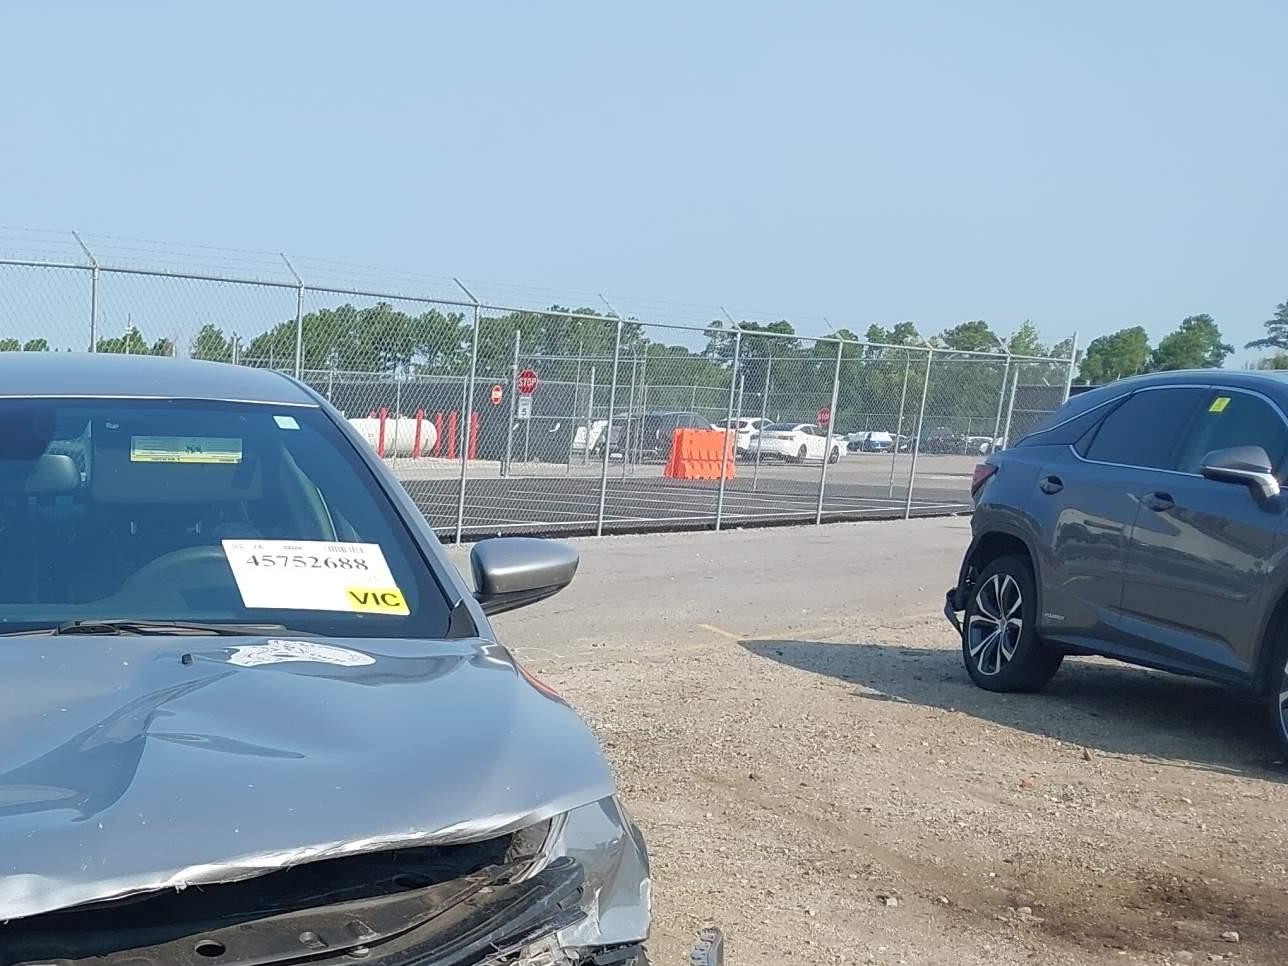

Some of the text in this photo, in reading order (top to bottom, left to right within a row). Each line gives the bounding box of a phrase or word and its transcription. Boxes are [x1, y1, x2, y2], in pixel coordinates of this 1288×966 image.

[518, 377, 536, 387] STOP
[246, 554, 369, 571] 45752688
[349, 591, 401, 607] VIC
